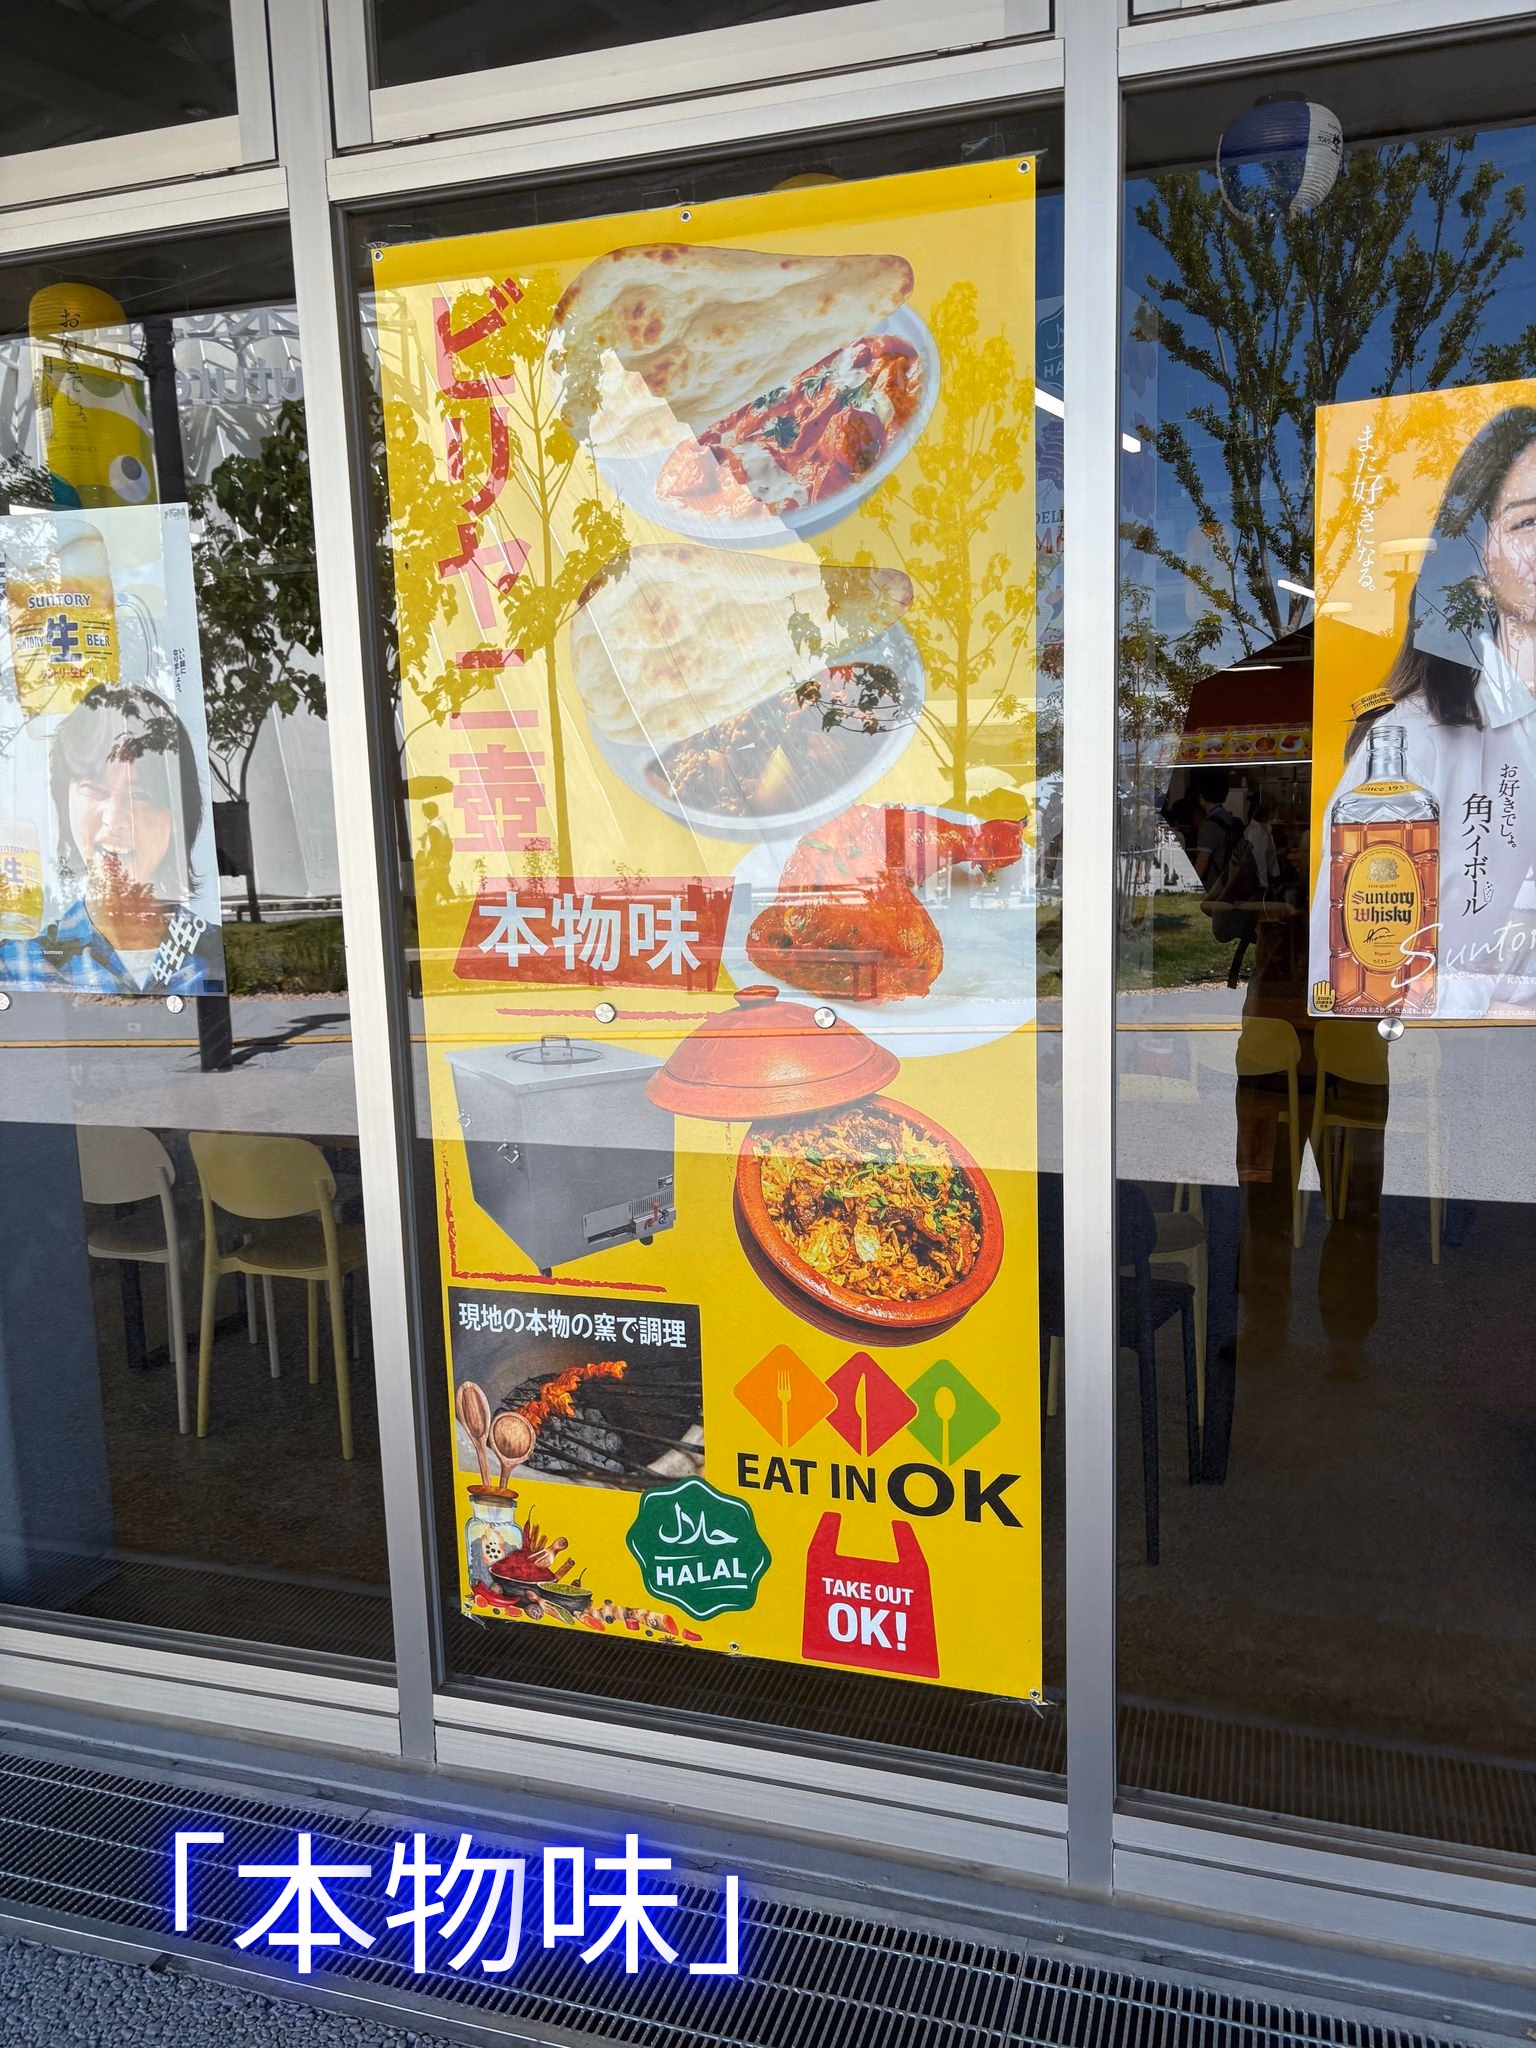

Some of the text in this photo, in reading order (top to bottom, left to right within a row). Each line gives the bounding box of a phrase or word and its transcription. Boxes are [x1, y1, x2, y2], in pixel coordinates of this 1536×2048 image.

[1352, 425, 1384, 591] また好きになる。
[28, 594, 90, 609] SUNTORY
[47, 614, 82, 662] 生
[86, 633, 110, 647] BEER
[1499, 763, 1520, 848] お好きでしょ。
[1462, 792, 1493, 918] 角ハイボール
[1352, 890, 1415, 908] Suntory
[1353, 906, 1412, 926] Whisky
[478, 891, 702, 976] 本物味
[458, 1302, 688, 1348] 現地の本物の窯で調理
[737, 1452, 1024, 1528] EAT IN OK
[658, 1501, 739, 1546] حلال
[656, 1557, 747, 1586] HALAL
[821, 1577, 914, 1606] TAKE OUT
[827, 1602, 908, 1652] OK!
